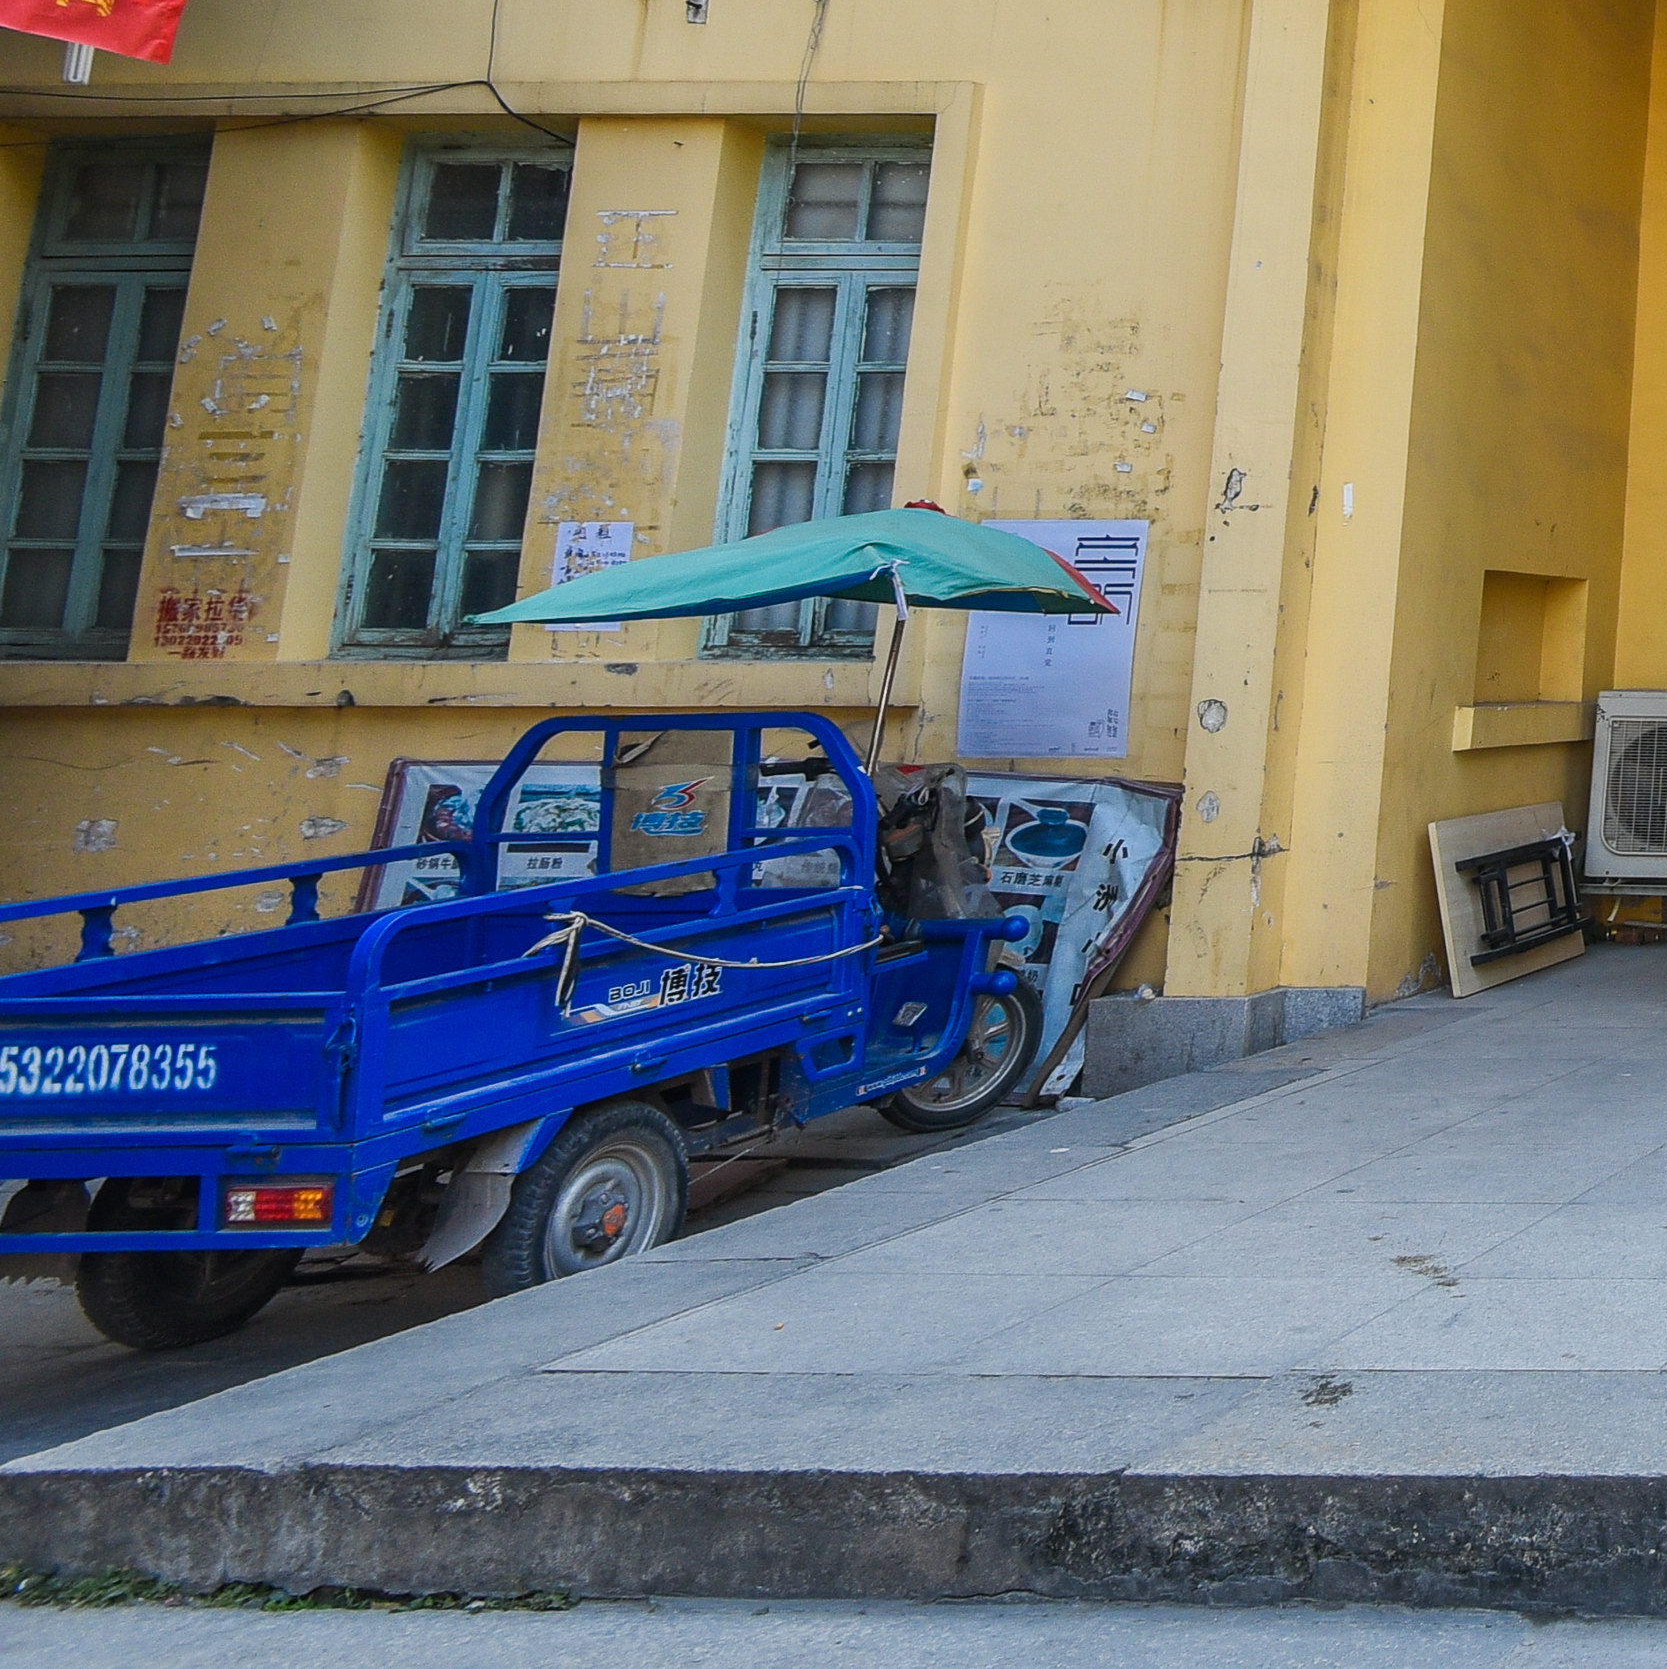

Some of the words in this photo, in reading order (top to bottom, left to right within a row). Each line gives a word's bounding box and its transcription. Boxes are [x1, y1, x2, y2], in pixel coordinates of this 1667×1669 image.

[630, 809, 709, 838] 博技
[525, 856, 564, 872] 拉肠粉
[608, 978, 651, 1003] BOJI
[659, 960, 724, 1007] 博技
[0, 1043, 218, 1095] 5322078355
